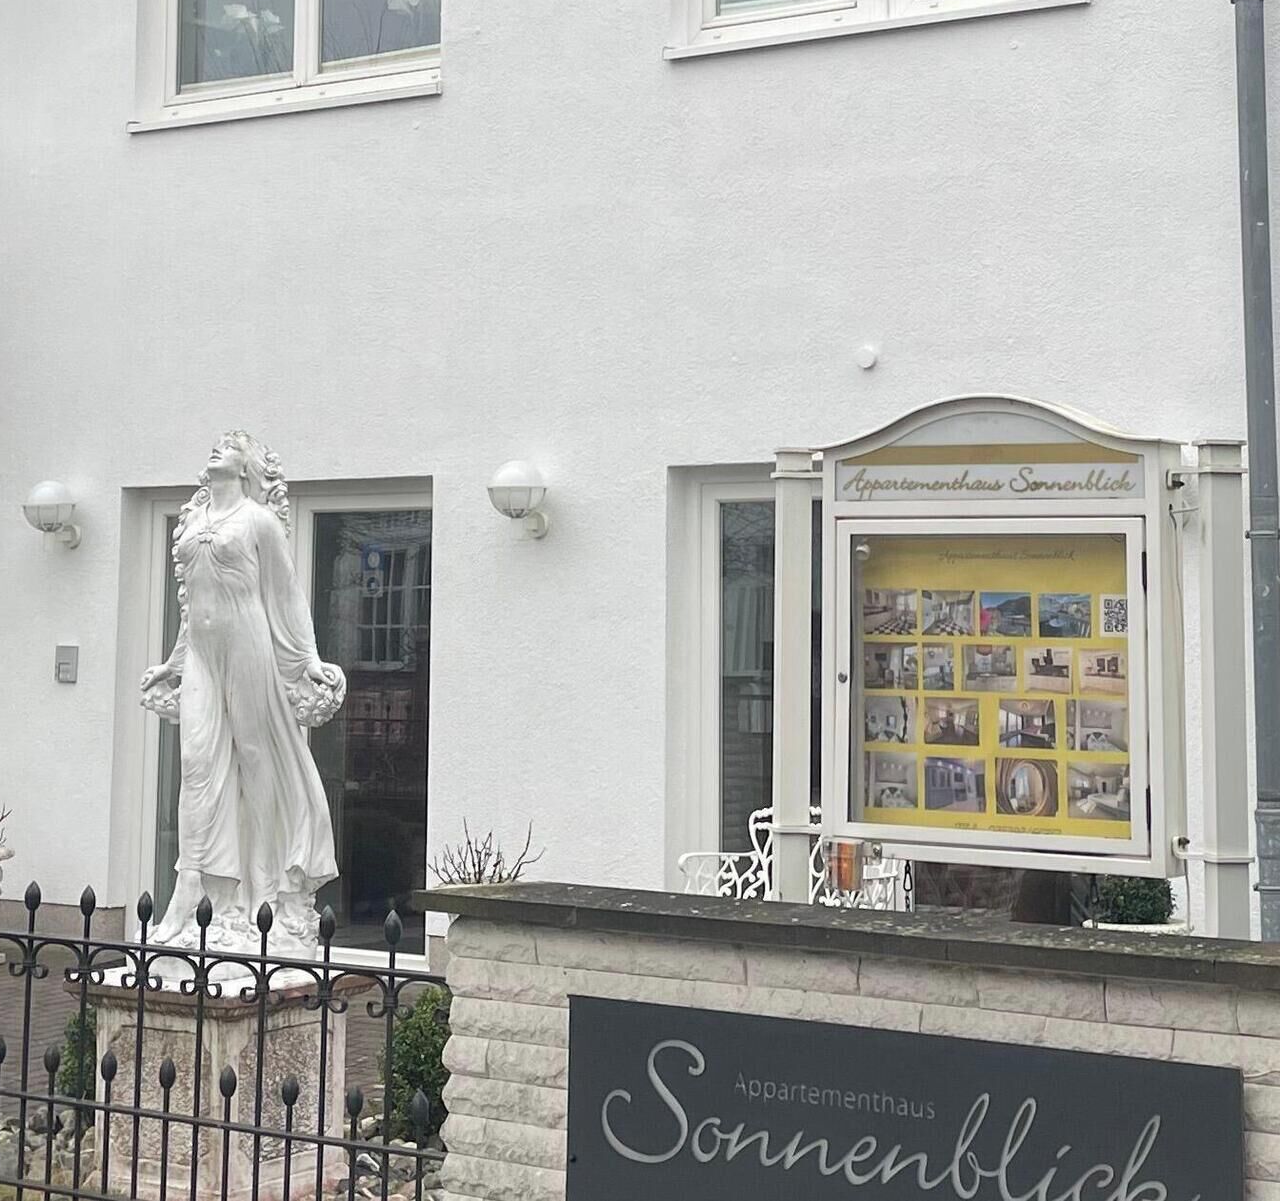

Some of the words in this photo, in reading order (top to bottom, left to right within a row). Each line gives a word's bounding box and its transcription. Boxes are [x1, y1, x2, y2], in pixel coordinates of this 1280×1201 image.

[842, 467, 1005, 499] Appartementhaus
[1010, 466, 1137, 494] Sonnenblick
[601, 1039, 1201, 1201] Sonnenblick
[734, 1070, 936, 1120] Appartementhaus
